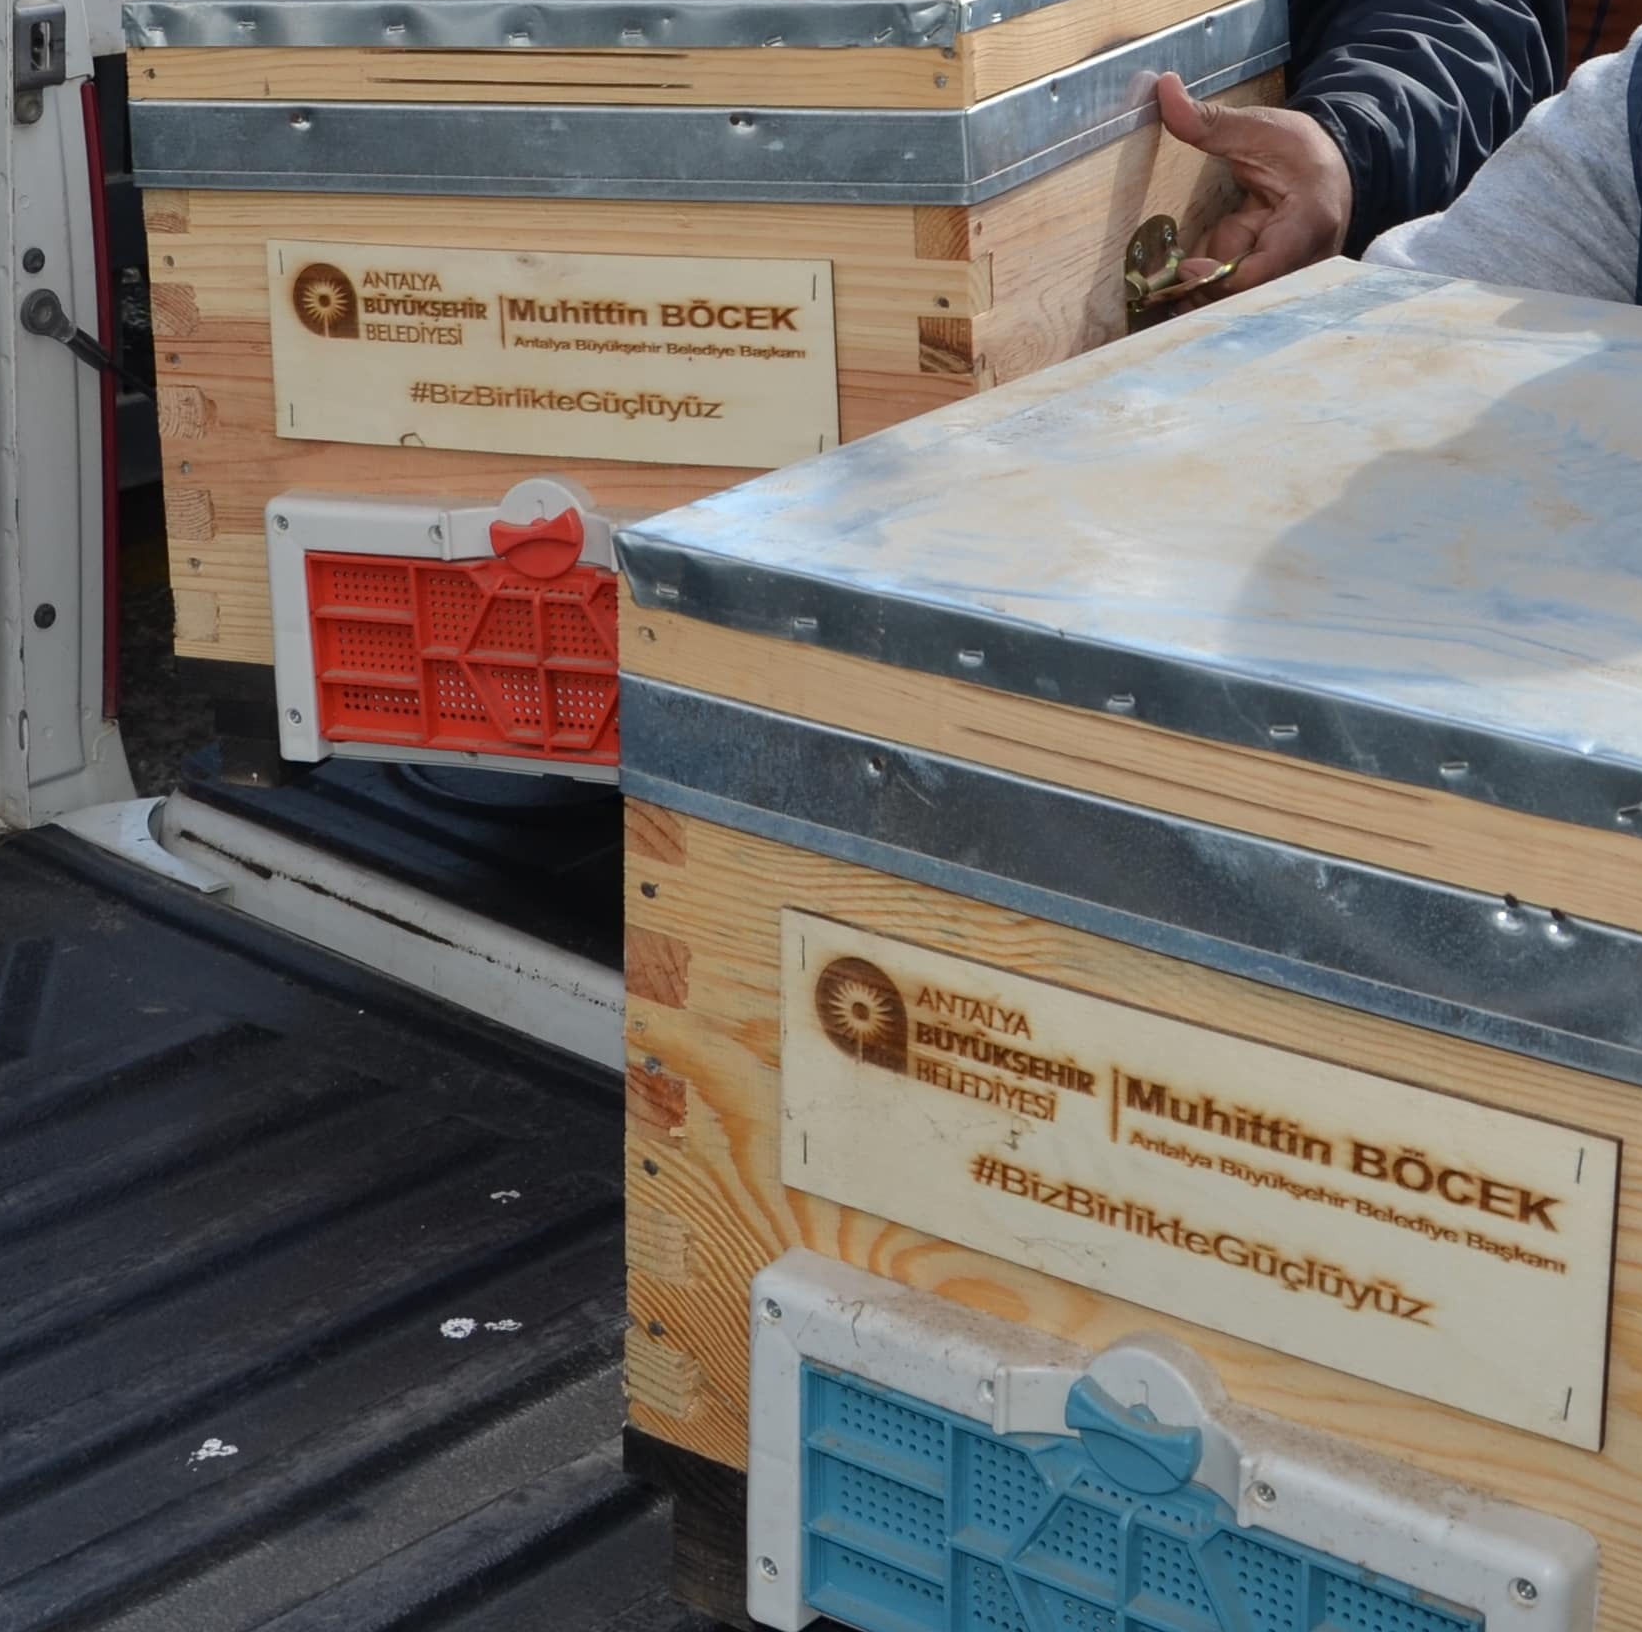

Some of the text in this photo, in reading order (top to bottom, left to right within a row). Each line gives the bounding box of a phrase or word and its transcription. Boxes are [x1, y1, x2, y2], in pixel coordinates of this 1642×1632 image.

[363, 272, 442, 292] ANTALYA
[364, 293, 488, 321] BÜYÜKŞEHİR
[508, 298, 799, 330] Muhittin BÖCEK
[366, 321, 463, 345] BELEDİYESİ
[514, 336, 806, 359] Antalya Büyükşehir Belediye Başkanı
[409, 380, 723, 422] #BizBirlikteGüçlüyüz
[916, 987, 1032, 1040] ANTALYA
[916, 1021, 1096, 1096] BÜYÜKŞEHİR
[916, 1057, 1055, 1122] BELEDİYESİ
[1125, 1076, 1561, 1232] Muhittin BÖCEK
[1128, 1129, 1566, 1275] Antalya Büyükşehir Belediye Başkanı
[969, 1153, 1434, 1326] #BizBirlikteGüçlüyüz
